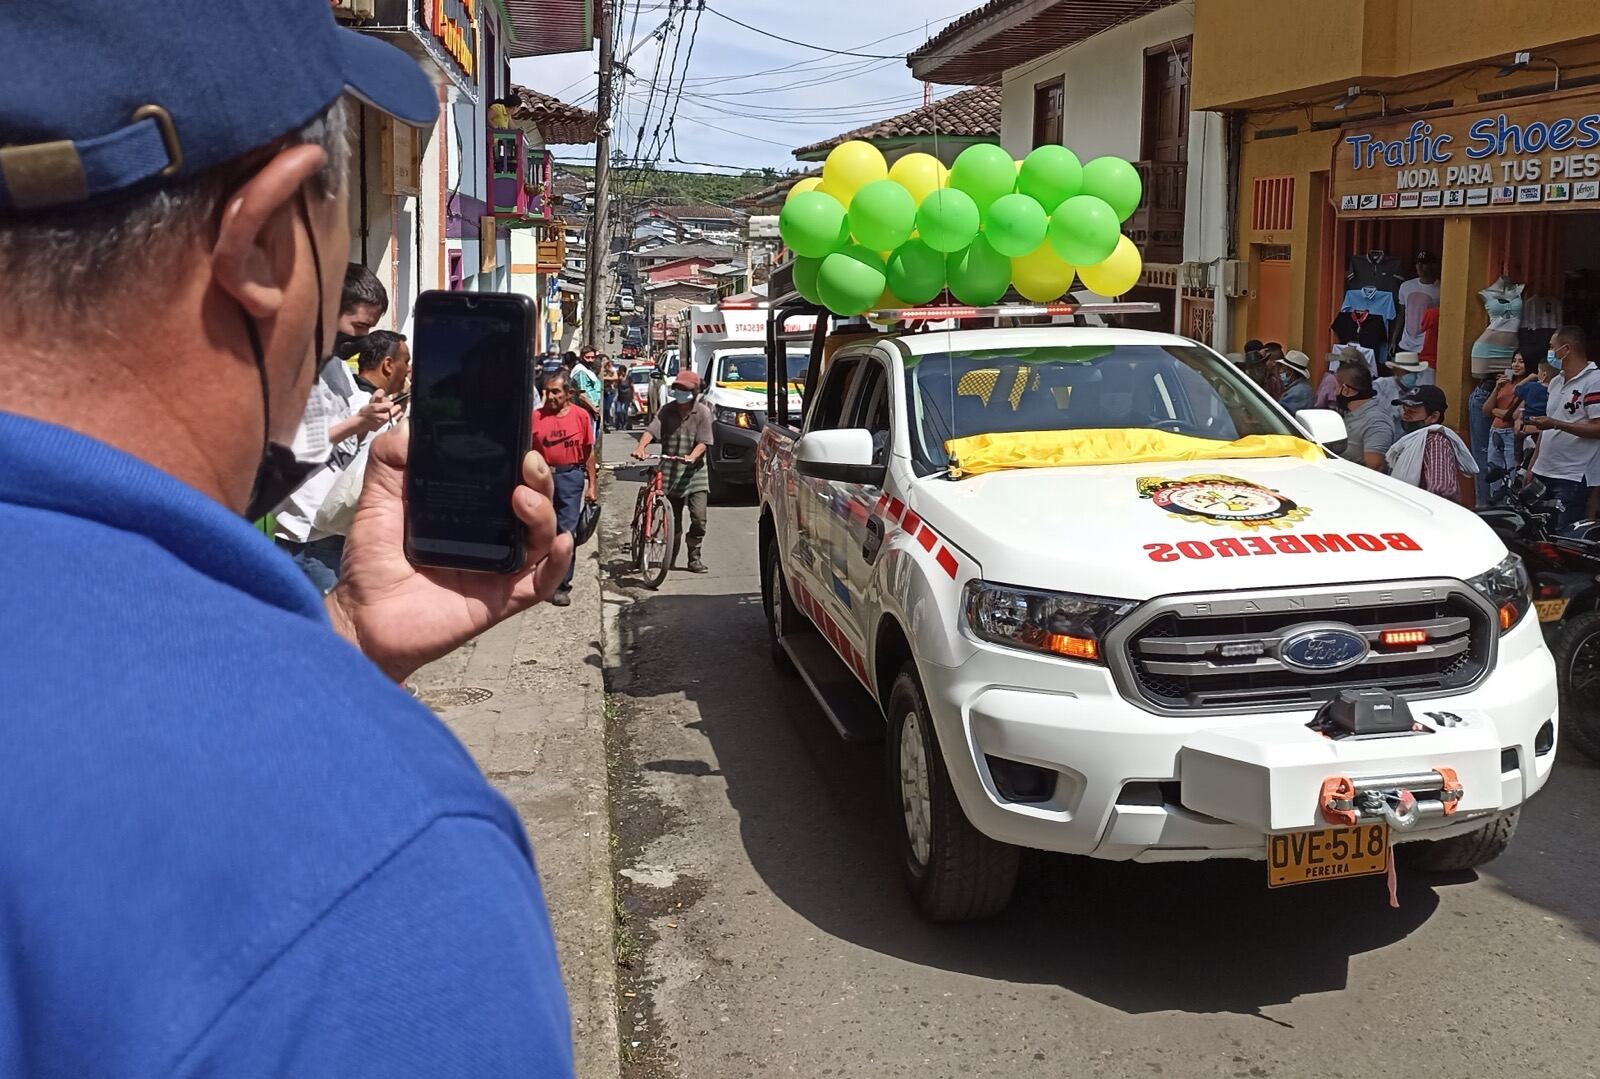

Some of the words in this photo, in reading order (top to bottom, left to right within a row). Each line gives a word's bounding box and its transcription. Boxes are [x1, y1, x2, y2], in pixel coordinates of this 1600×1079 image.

[1346, 120, 1453, 170] Trafic
[1466, 113, 1600, 159] Shoes
[1397, 167, 1439, 189] MODA
[1446, 163, 1493, 186] PARA
[1501, 158, 1541, 182] TUS
[1550, 153, 1600, 178] PIES
[550, 429, 567, 438] JUST
[1192, 588, 1437, 616] RANGER
[1303, 638, 1349, 661] Ford
[1305, 863, 1350, 878] PEREIRA
